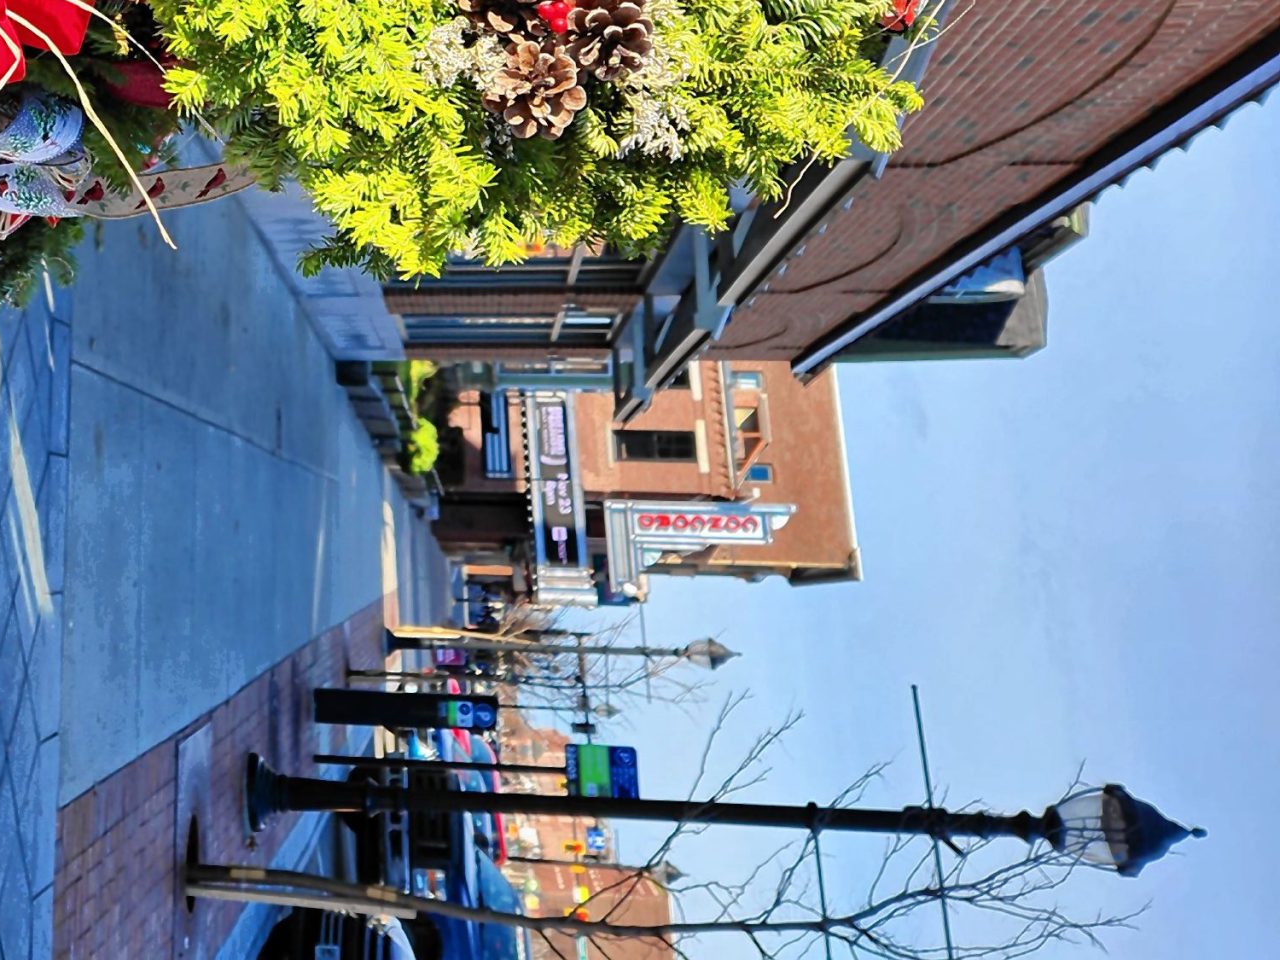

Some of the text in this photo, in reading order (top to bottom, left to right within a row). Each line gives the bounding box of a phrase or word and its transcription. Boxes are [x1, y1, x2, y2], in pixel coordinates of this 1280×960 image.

[557, 472, 570, 497] Nov
[558, 498, 573, 515] 23
[637, 514, 761, 533] CONCORD
[476, 711, 492, 722] P
